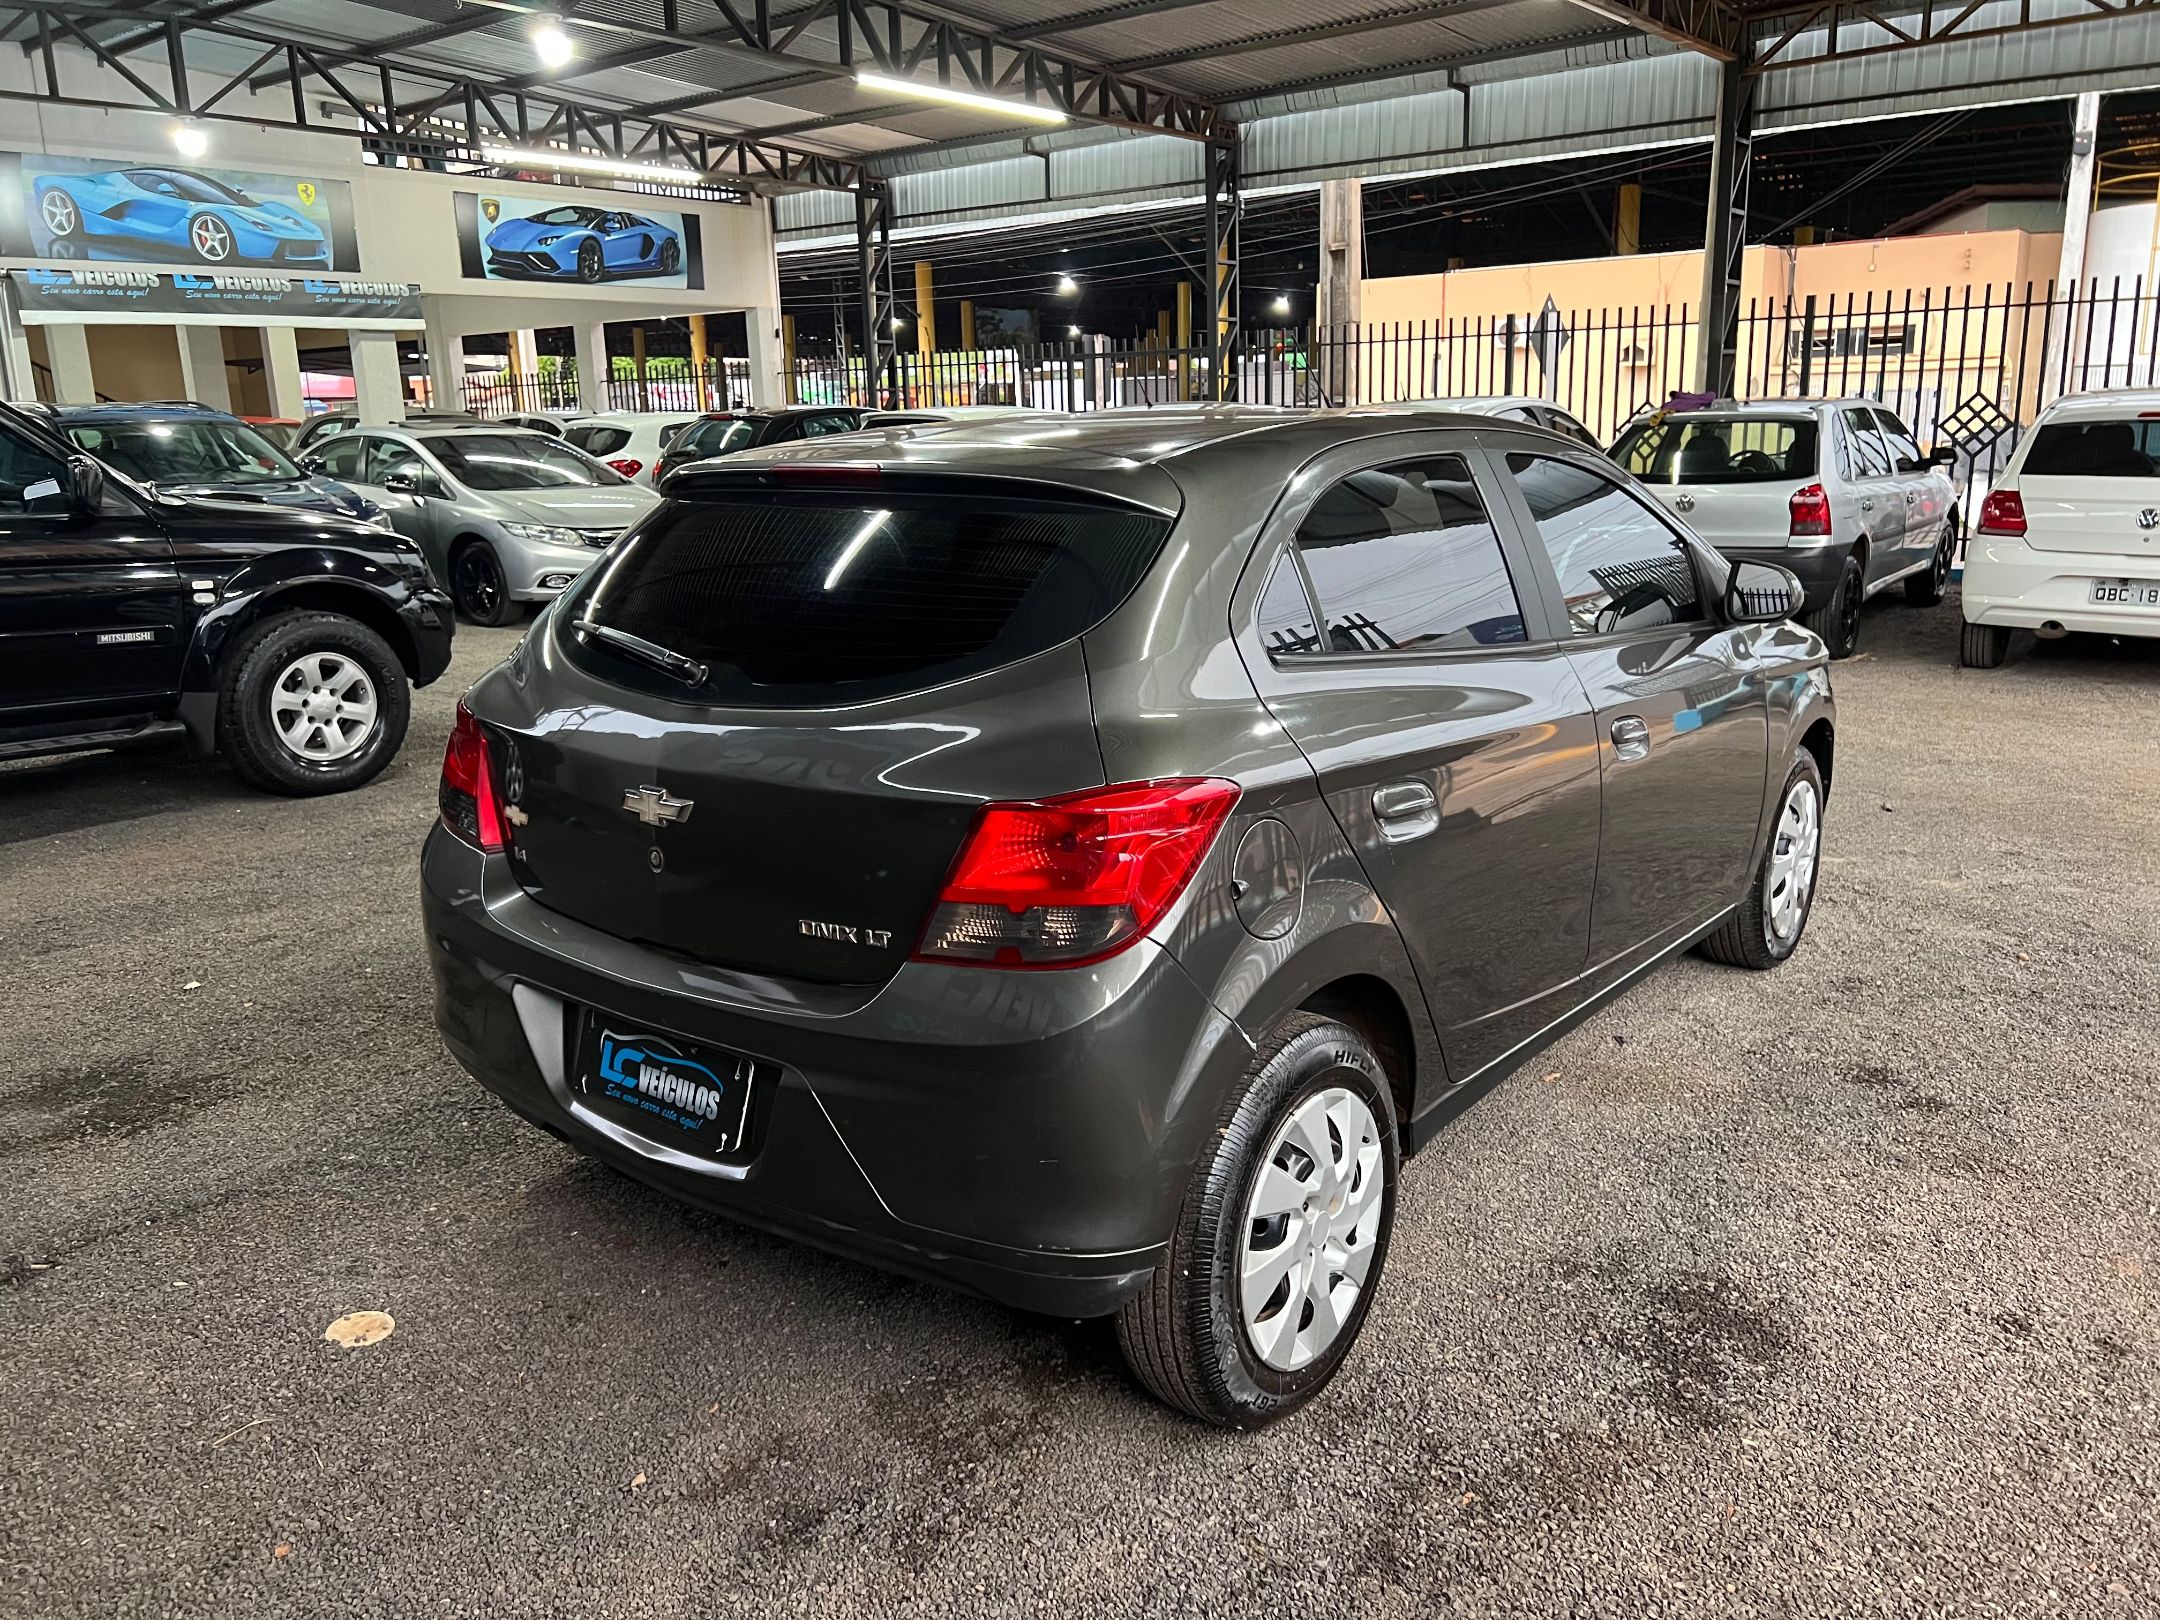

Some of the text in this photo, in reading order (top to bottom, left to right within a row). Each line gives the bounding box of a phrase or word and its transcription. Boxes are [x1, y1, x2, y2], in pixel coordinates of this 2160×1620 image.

[41, 285, 59, 295] Seu
[83, 287, 105, 296] carro
[127, 287, 150, 299] aqui!
[185, 289, 202, 299] Seu
[315, 294, 330, 303] Seu
[101, 631, 151, 642] MITSUBISHI
[798, 919, 892, 949] ONIX LT
[600, 1039, 721, 1121] LC VEÍCULOS
[604, 1083, 622, 1098] Seu
[622, 1093, 640, 1105] novo
[640, 1100, 661, 1114] carro
[679, 1116, 704, 1132] aqui!
